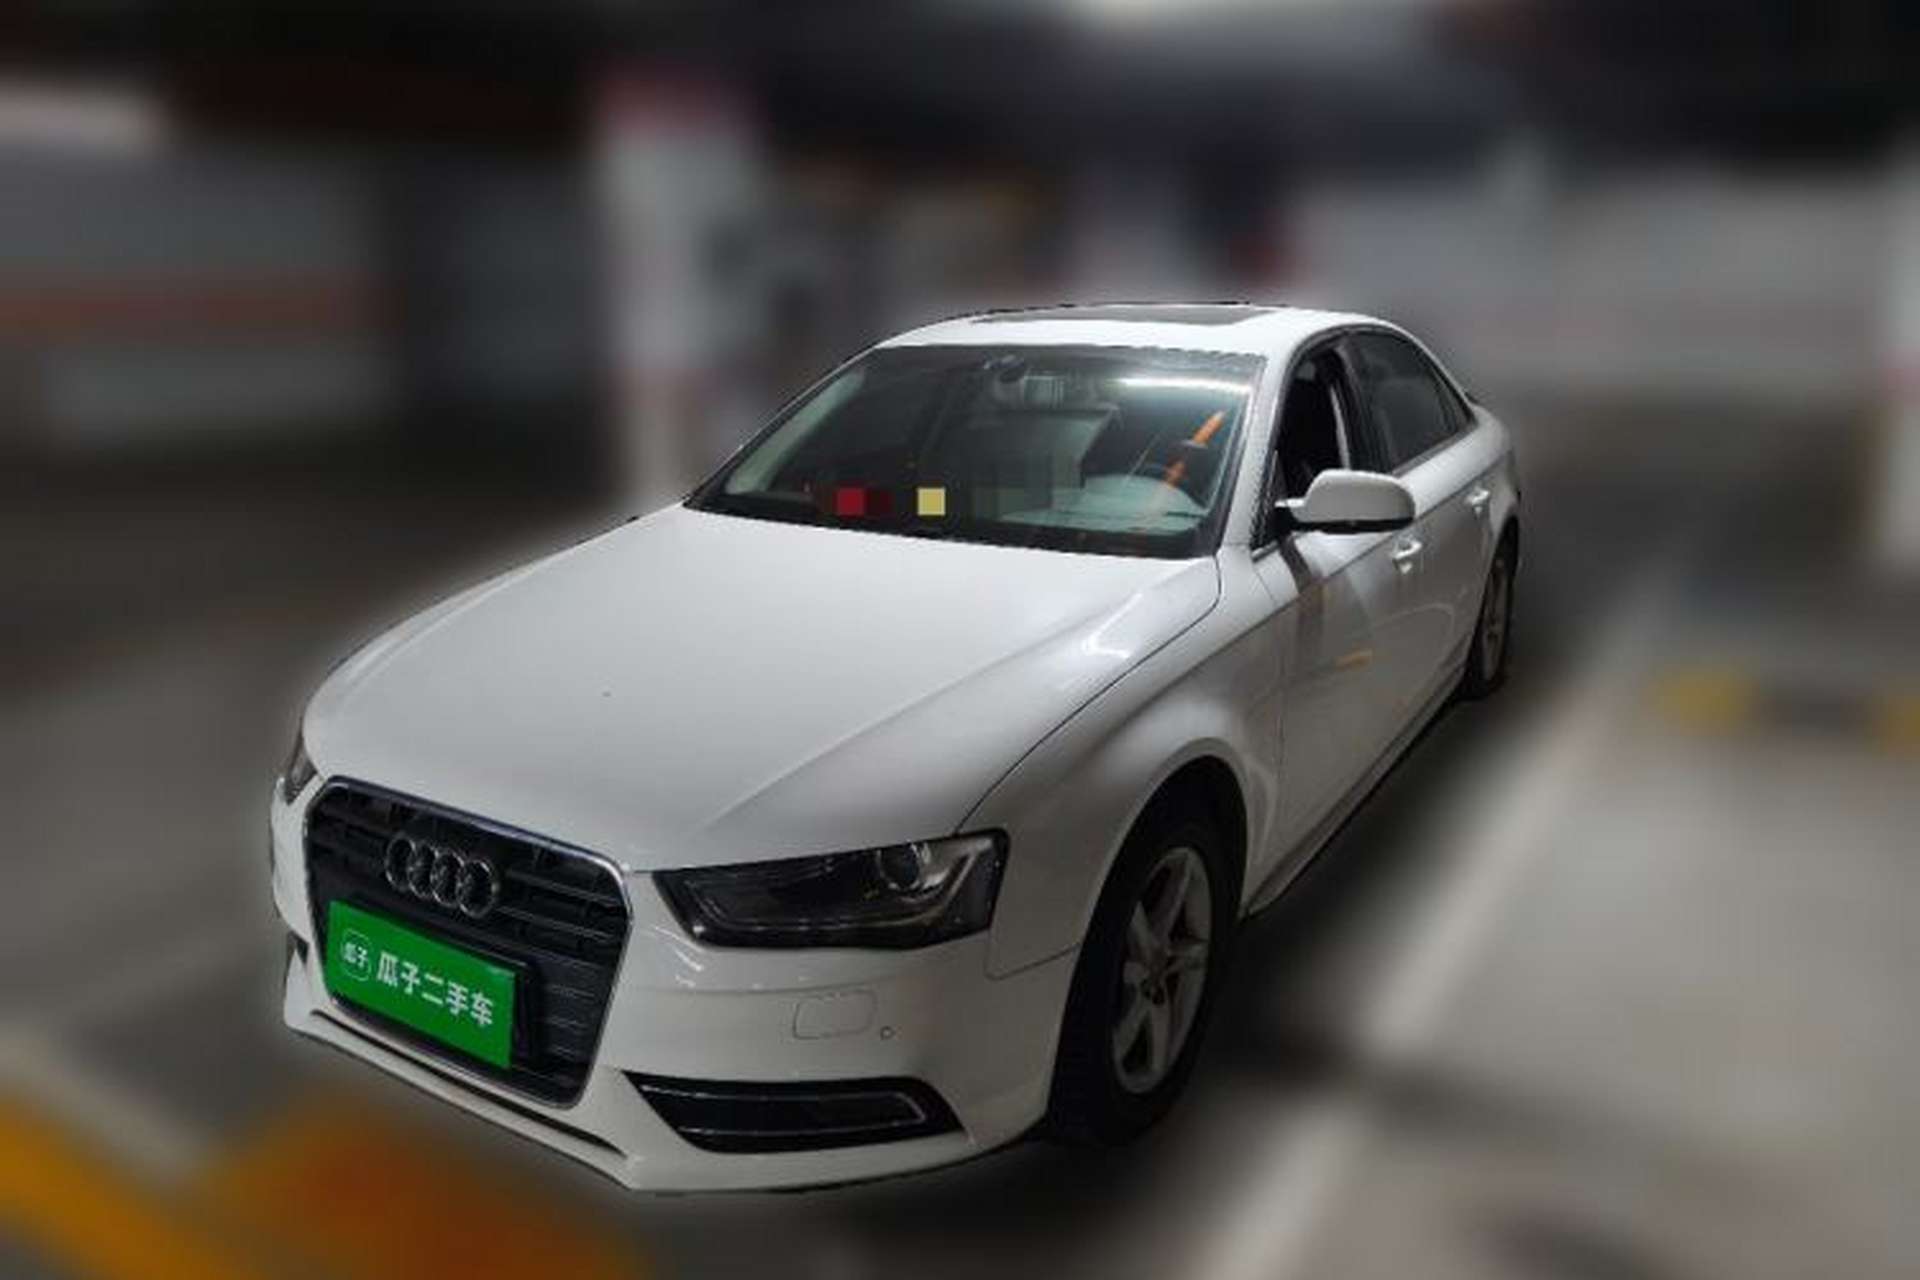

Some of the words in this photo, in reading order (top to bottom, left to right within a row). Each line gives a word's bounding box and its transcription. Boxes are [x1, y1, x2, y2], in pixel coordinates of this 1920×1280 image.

[377, 951, 493, 1027] 瓜子二手车
